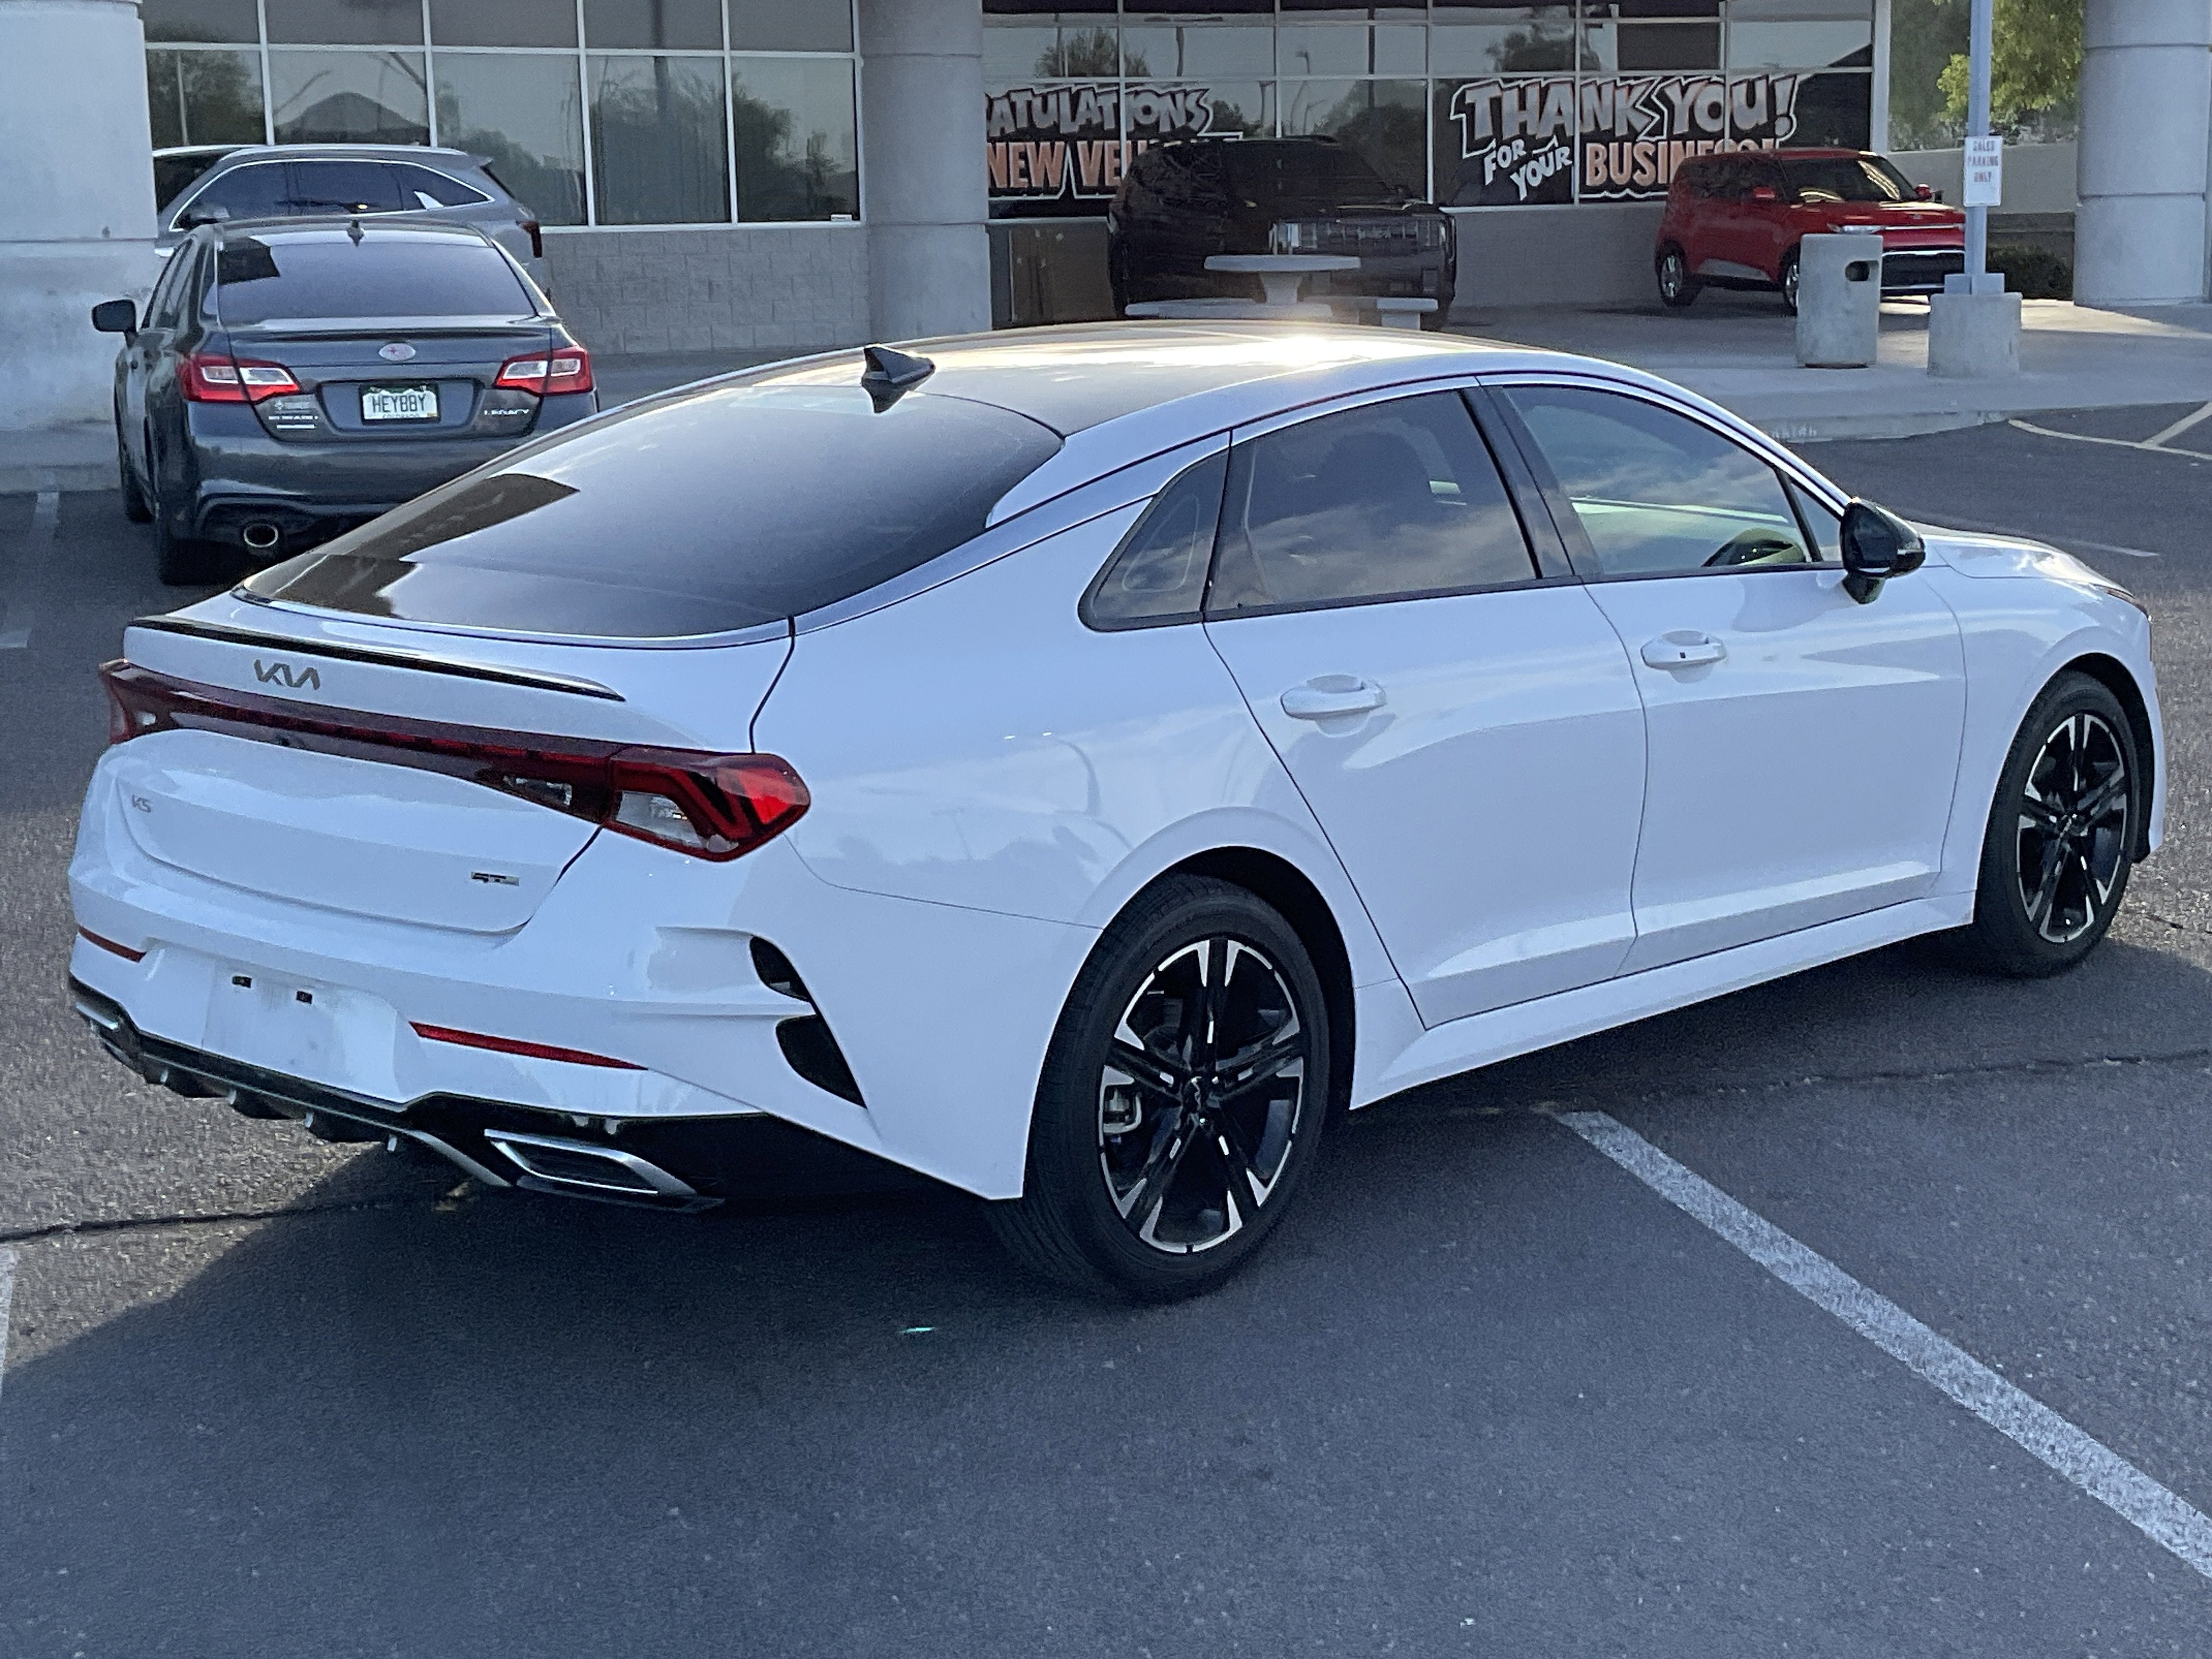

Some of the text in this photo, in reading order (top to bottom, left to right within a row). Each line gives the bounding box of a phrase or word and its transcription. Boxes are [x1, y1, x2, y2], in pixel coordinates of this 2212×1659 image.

[986, 87, 1207, 137] ATULATIONS
[1465, 75, 1796, 139] THANK YOU!
[988, 141, 1065, 188] NEW
[1483, 139, 1526, 185] FOR
[1968, 156, 1999, 166] PARKING
[1973, 140, 1995, 151] SALES
[1510, 145, 1572, 201] YOUR
[1974, 172, 1992, 182] ONLY
[132, 794, 151, 813] K5
